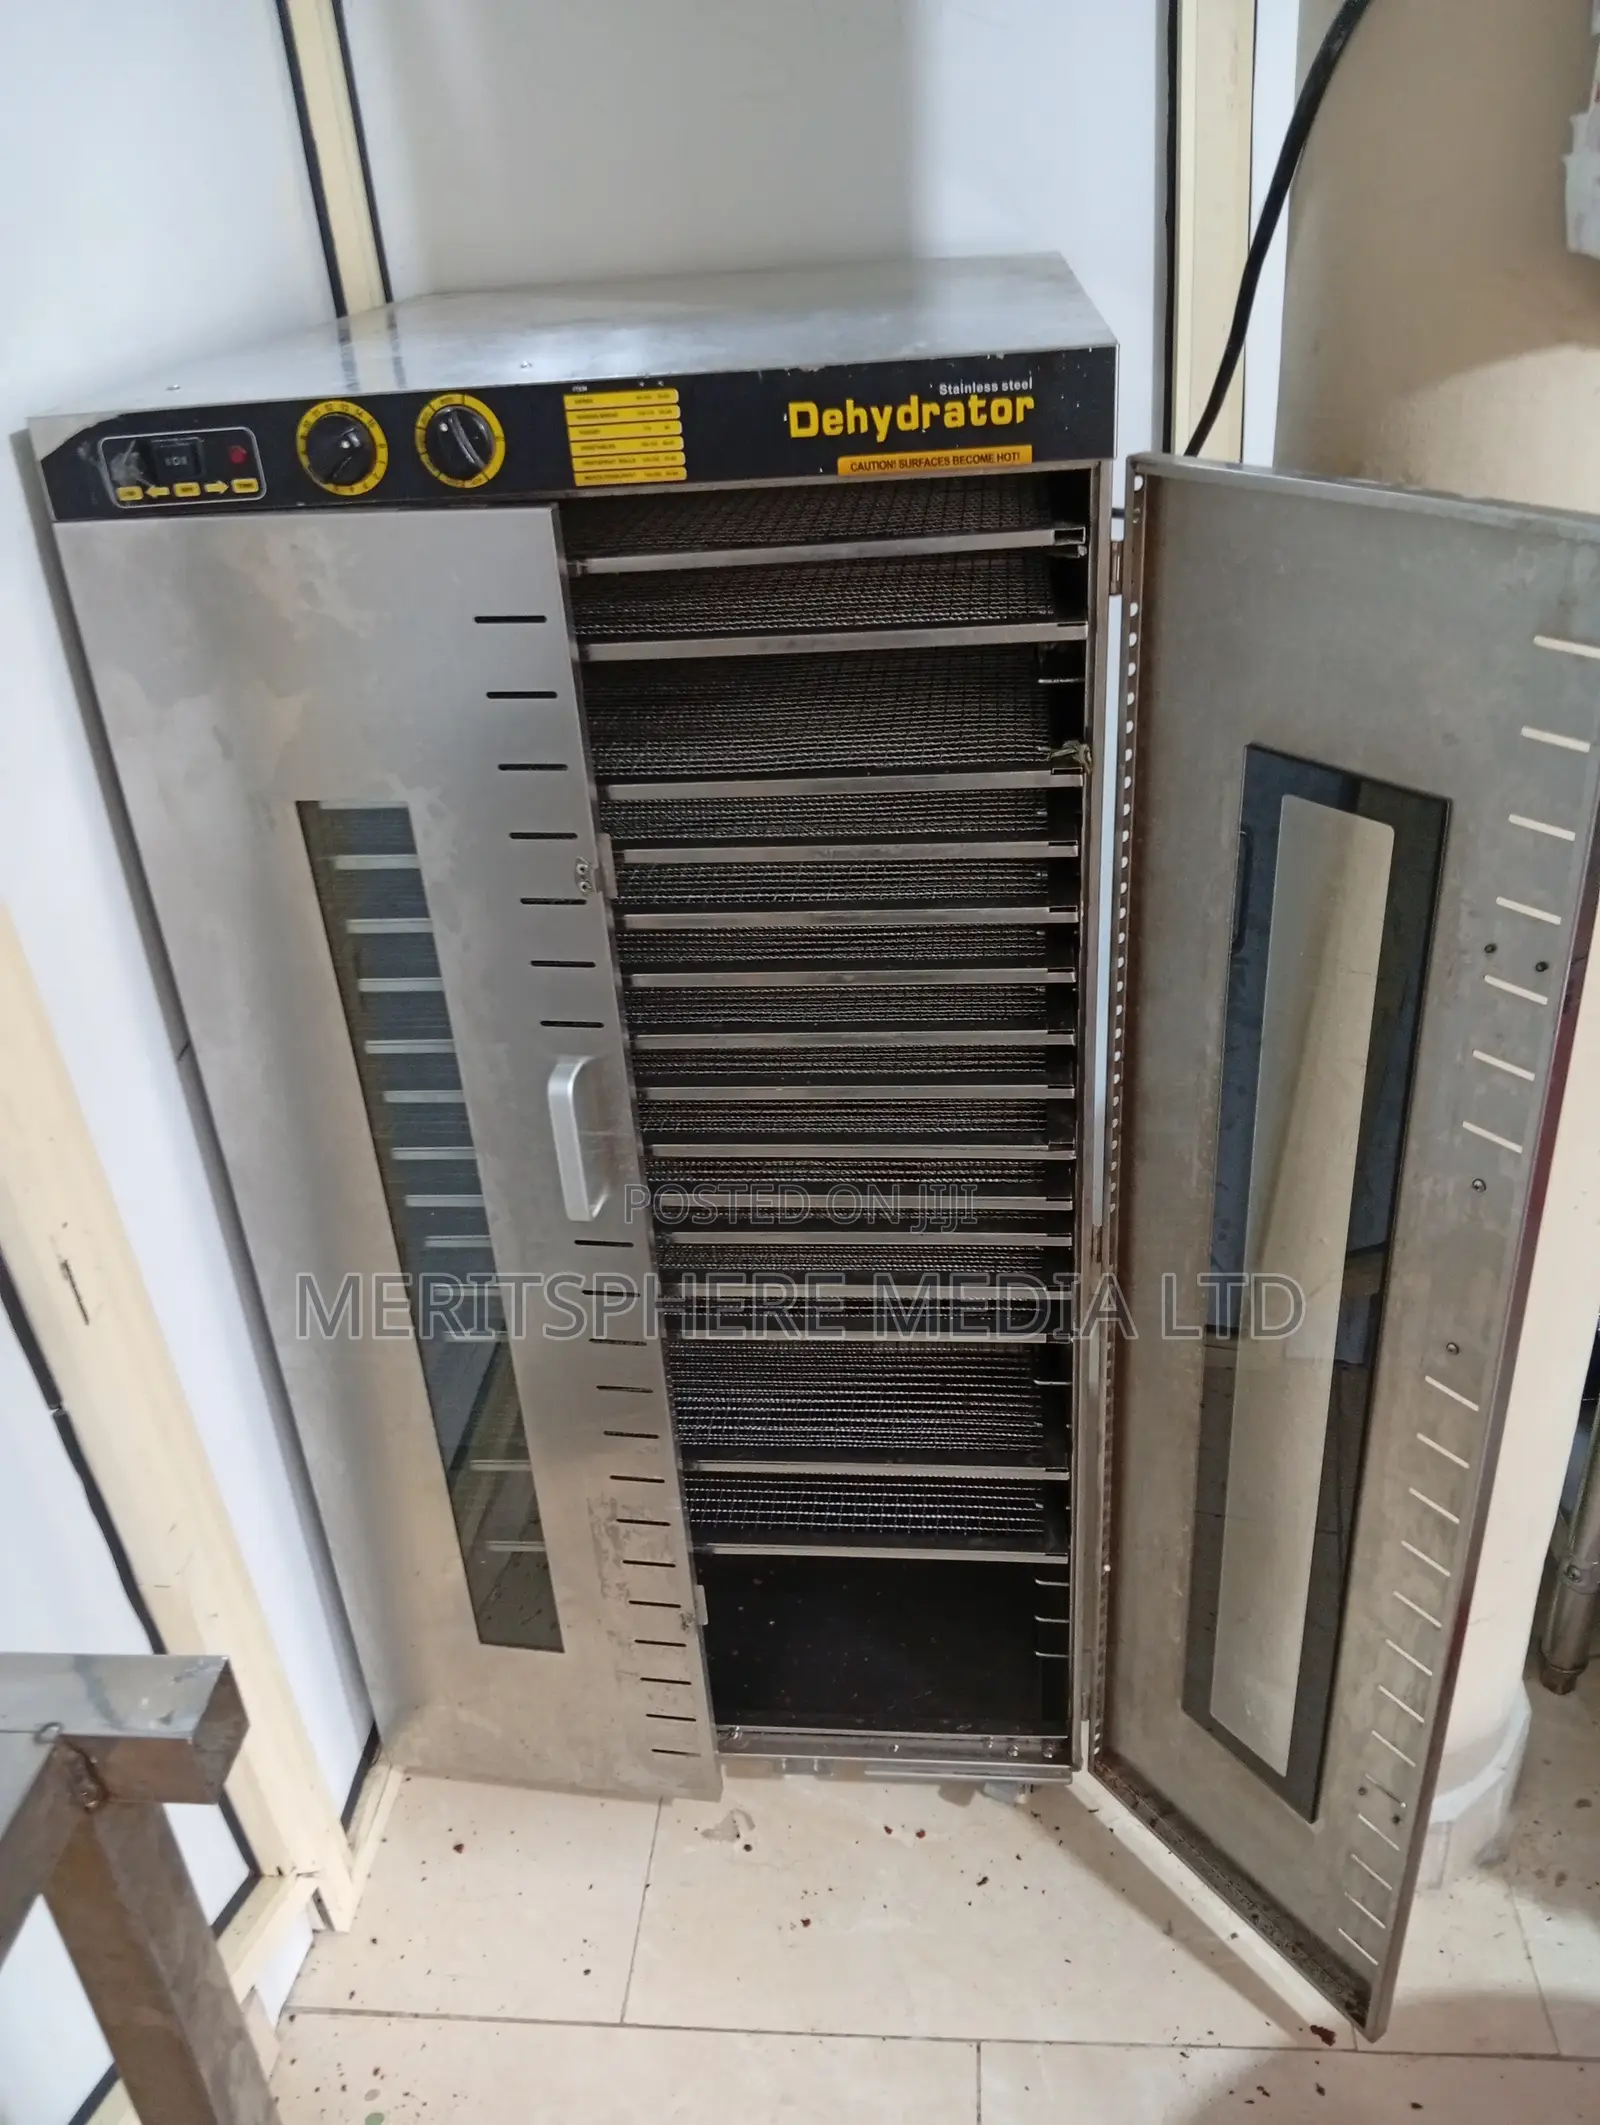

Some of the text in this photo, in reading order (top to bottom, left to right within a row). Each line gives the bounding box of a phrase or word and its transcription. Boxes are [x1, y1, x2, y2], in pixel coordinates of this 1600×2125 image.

[939, 376, 1033, 396] Stainless steel
[788, 395, 1035, 443] Dehydrator
[850, 452, 1021, 473] CAUTION! SURFACES BECOME HOT!
